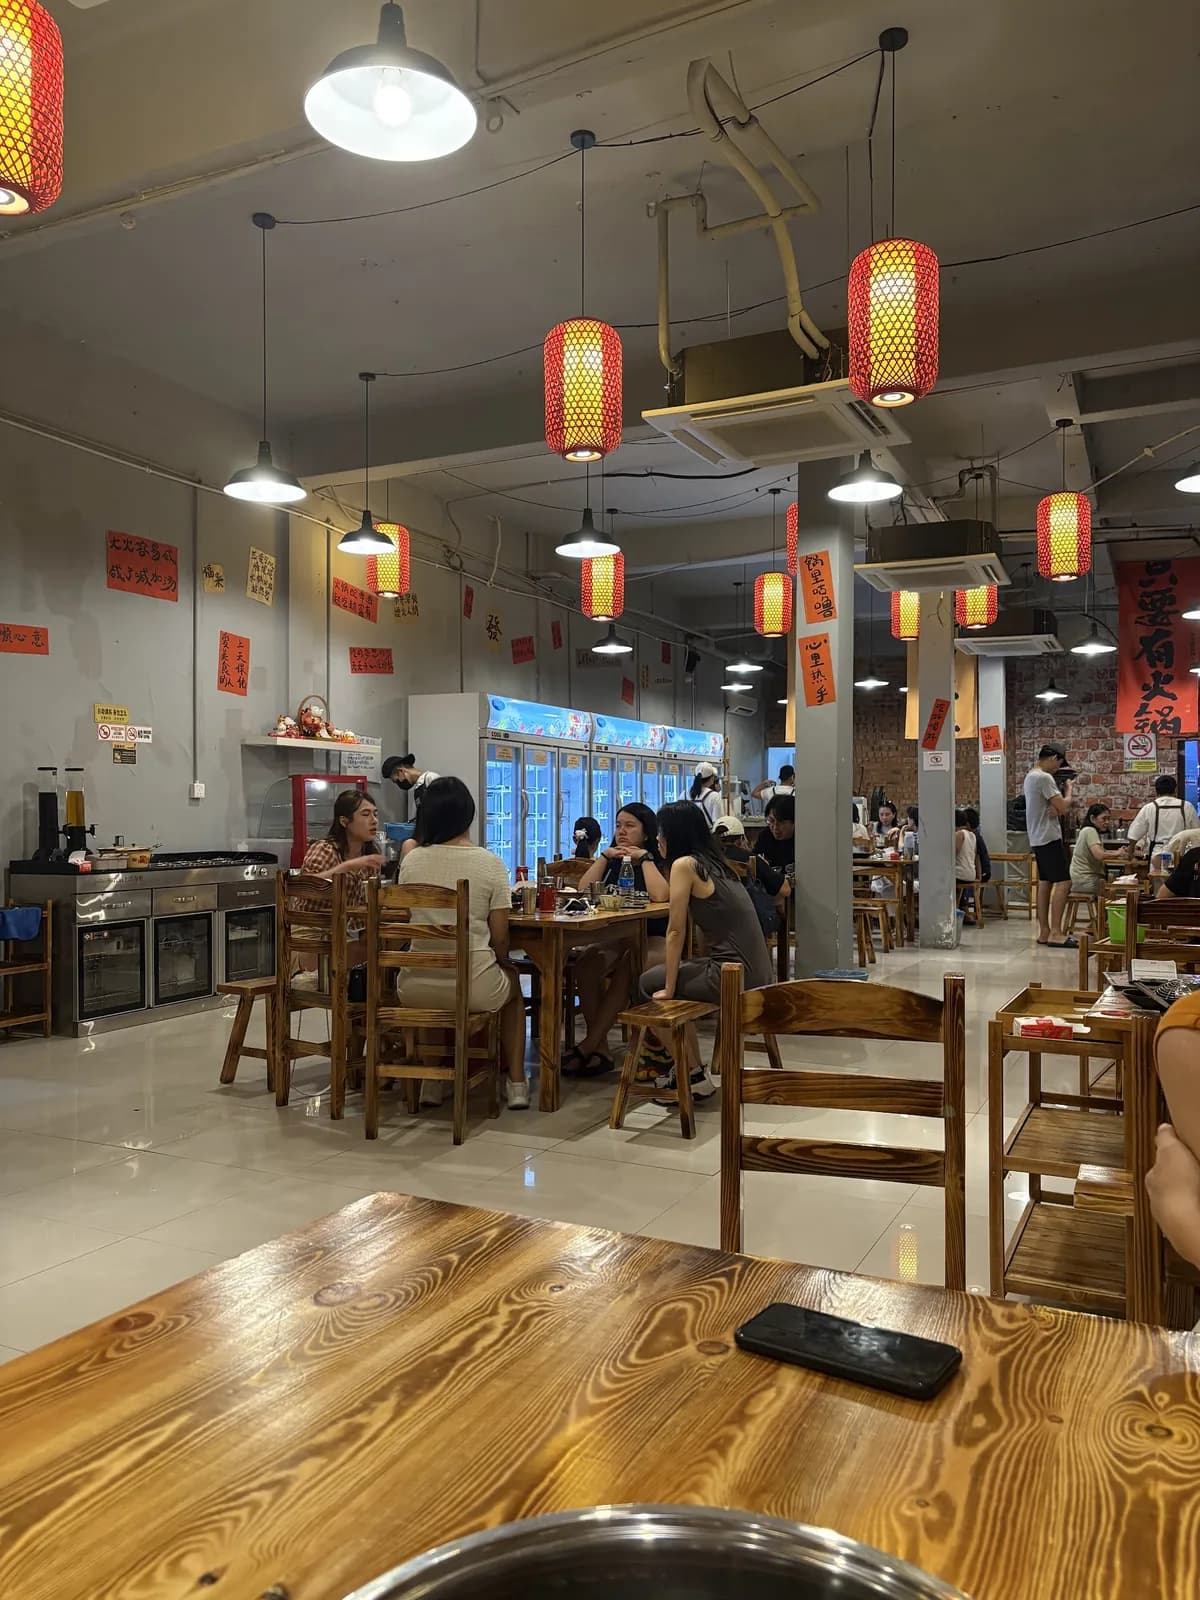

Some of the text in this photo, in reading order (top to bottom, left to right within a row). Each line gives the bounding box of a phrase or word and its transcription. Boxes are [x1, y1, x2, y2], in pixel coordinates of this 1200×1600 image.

[804, 554, 834, 619] 锅里咕噜
[805, 638, 829, 705] 心里热乎
